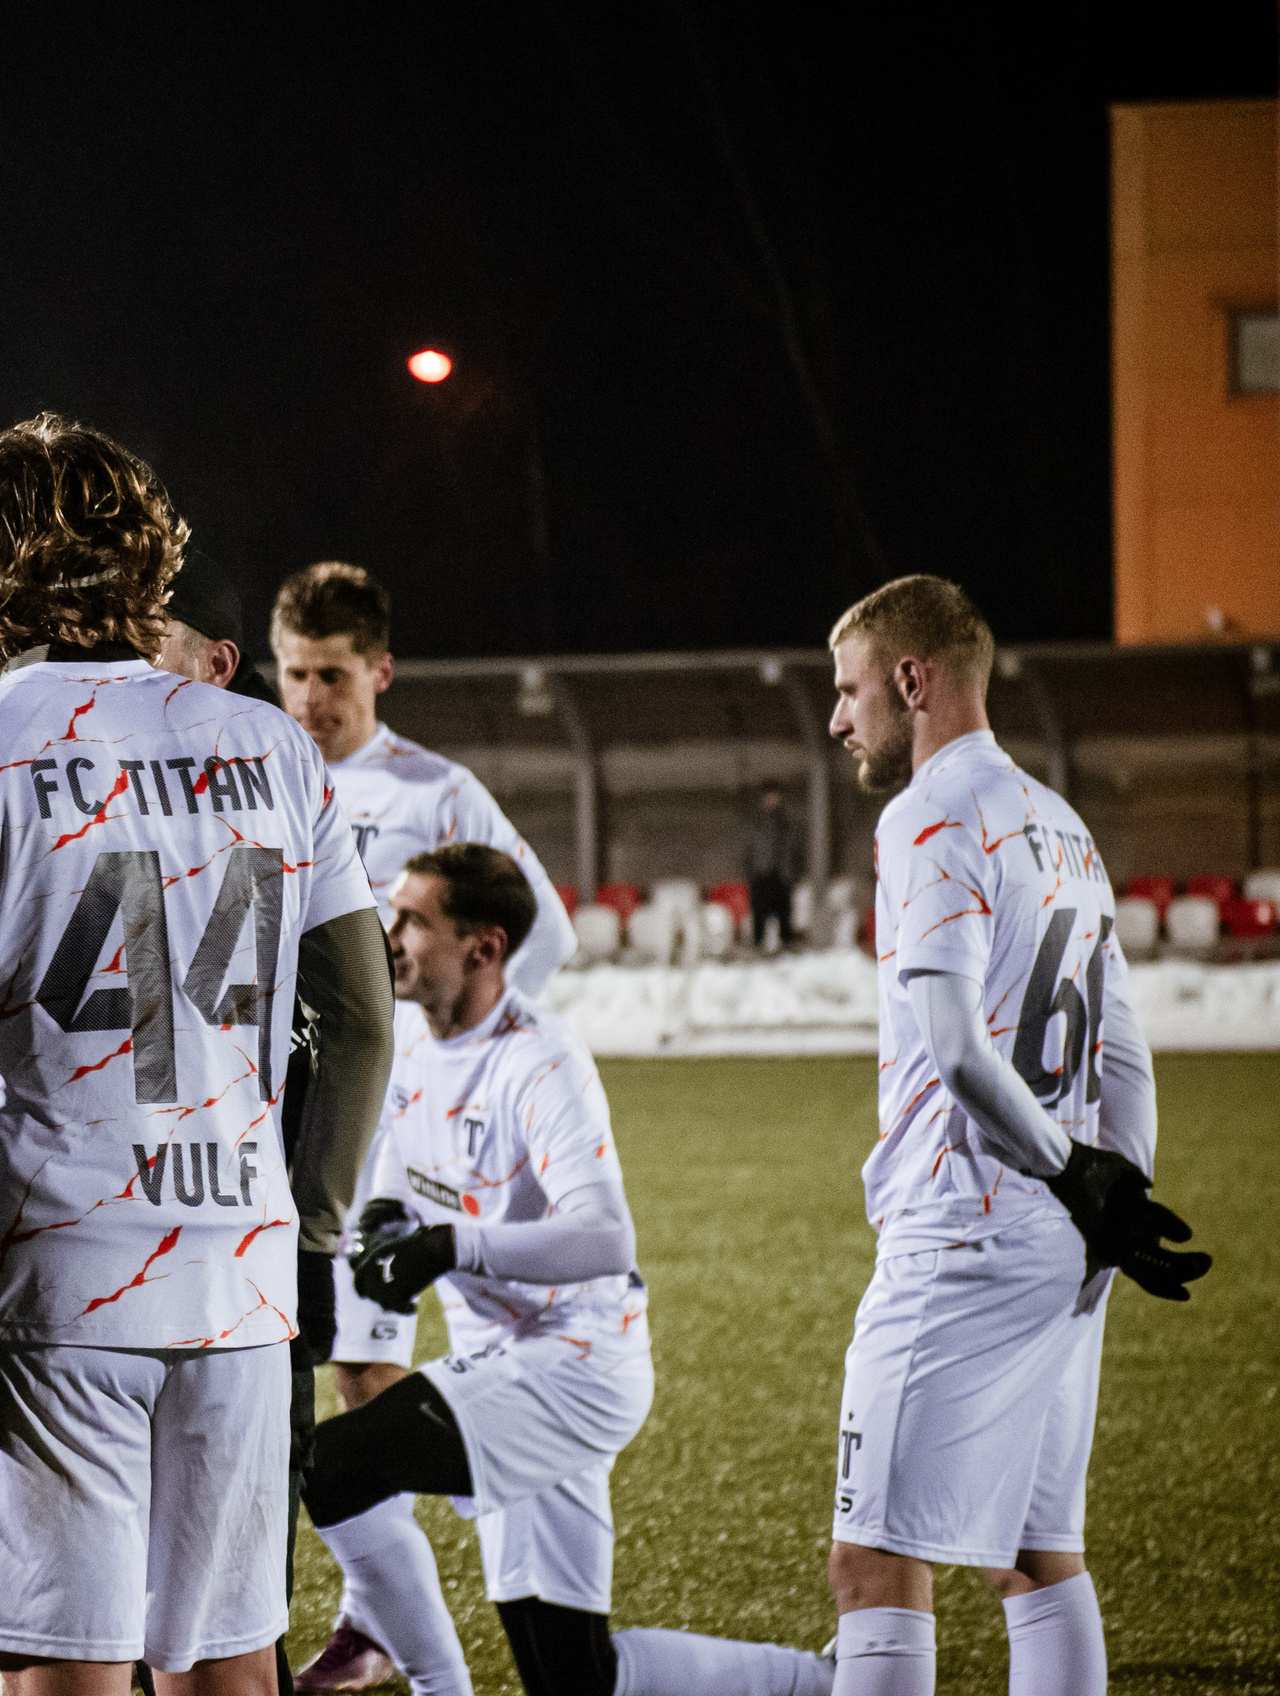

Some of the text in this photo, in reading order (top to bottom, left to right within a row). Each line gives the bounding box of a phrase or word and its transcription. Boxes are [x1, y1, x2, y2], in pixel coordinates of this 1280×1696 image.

[31, 756, 275, 819] FC TITAN
[1023, 824, 1059, 874] FC
[35, 848, 283, 1104] 44
[132, 1141, 257, 1207] VULF
